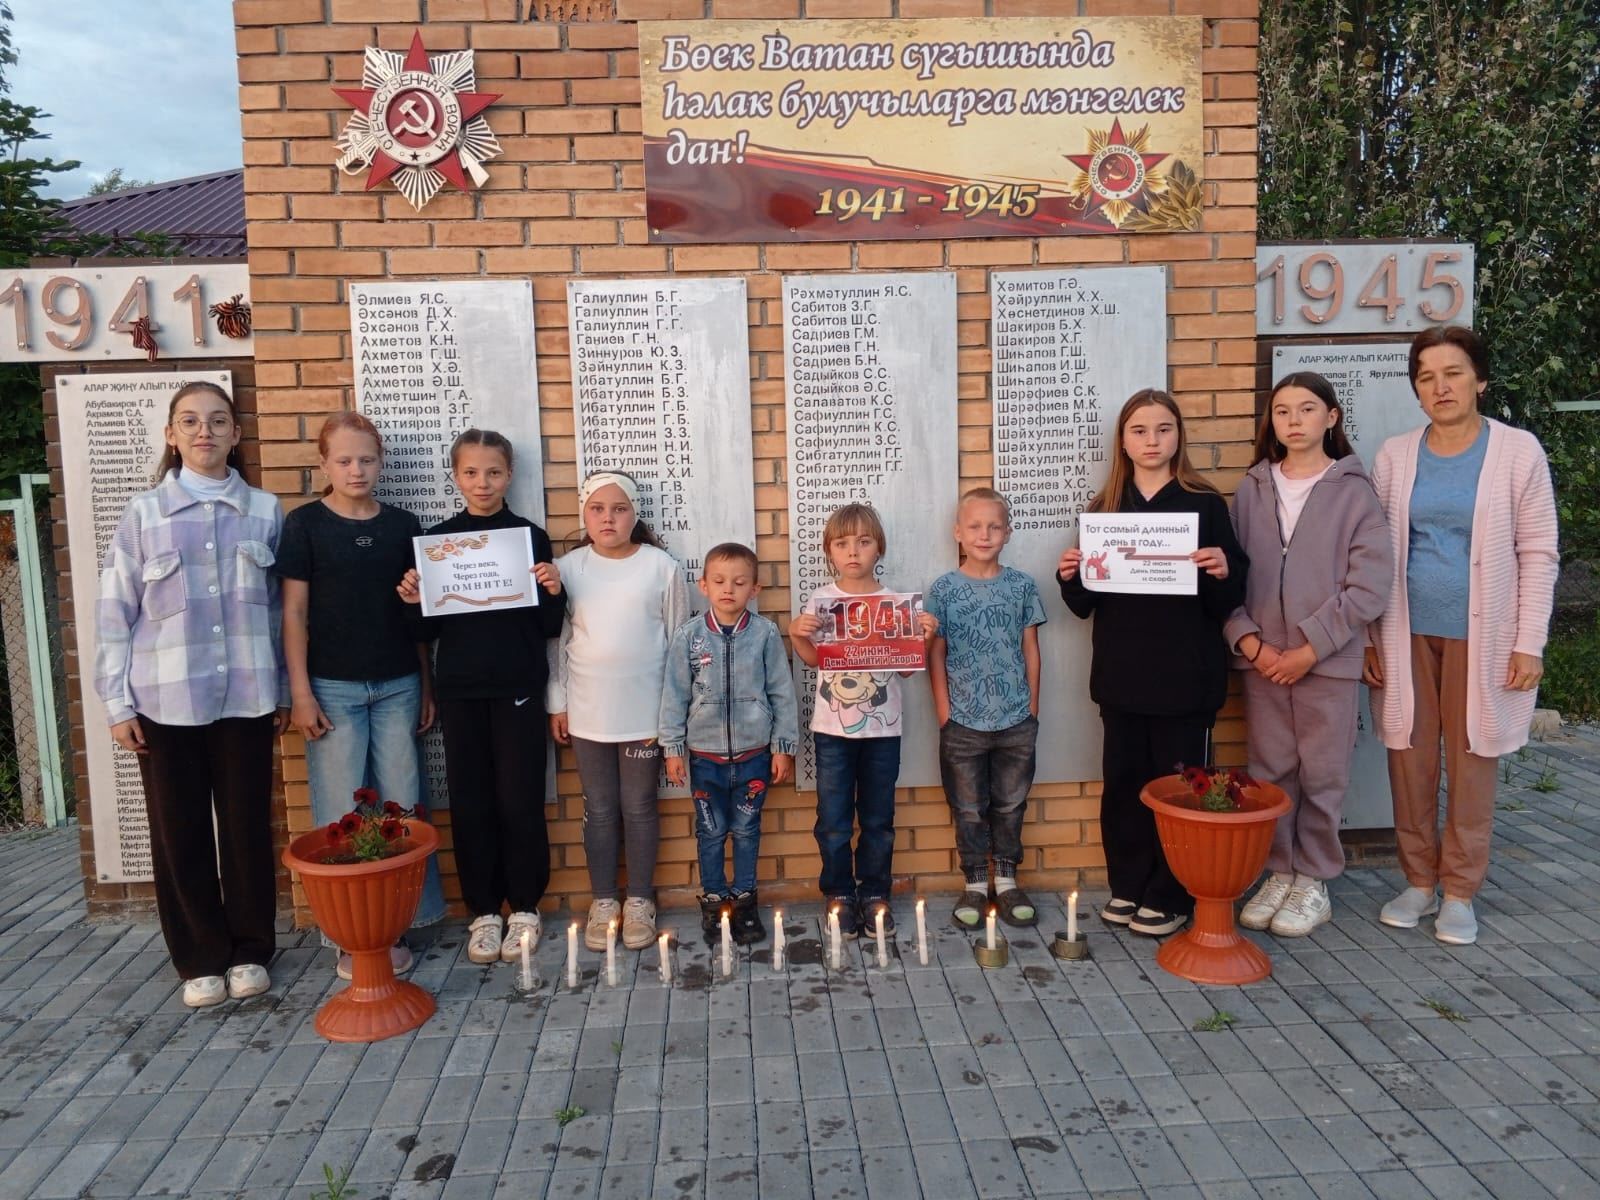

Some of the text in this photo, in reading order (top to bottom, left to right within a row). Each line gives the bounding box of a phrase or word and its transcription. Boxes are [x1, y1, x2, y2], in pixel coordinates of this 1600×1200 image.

[661, 31, 1114, 80] Бөек Ватан сүгышында
[662, 79, 1186, 128] һәлак булучыларга мәнгелек
[665, 130, 750, 169] дан!
[814, 185, 906, 221] 1941
[945, 183, 1041, 219] 1945
[997, 281, 1054, 292] Хәмитов
[1258, 252, 1465, 324] 1945
[358, 294, 411, 306] Әлмиев
[575, 292, 647, 306] Галиуллин
[791, 288, 880, 301] Рәхмәтуллин
[997, 292, 1072, 306] Хәйруллин
[0, 274, 204, 351] 1941
[358, 308, 418, 319] Әхсәнов
[576, 306, 648, 320] Галиуллин
[792, 302, 847, 313] Сабитов
[998, 307, 1085, 320] Хөснетдинов
[360, 321, 419, 332] Әхсәнов
[576, 320, 649, 333] Галиуллин
[792, 315, 847, 327] Сабитов
[997, 321, 1055, 334] Шакиров
[361, 336, 421, 347] Ахметов
[577, 334, 625, 345] Ганиев
[792, 329, 850, 342] Садриев
[997, 335, 1055, 348] Шакиров
[793, 342, 850, 355] Садриев
[997, 349, 1056, 361] Шиһапов
[361, 350, 422, 361] Ахметов
[362, 364, 423, 374] Ахметов
[579, 360, 653, 373] Зәйнуллин
[793, 357, 850, 368] Садриев
[997, 363, 1056, 374] Шиһапов
[363, 377, 424, 388] Ахметов
[580, 375, 654, 387] Ибатуллин
[794, 370, 859, 382] Садыйков
[998, 376, 1056, 387] Шиһапов
[580, 388, 654, 401] Ибатуллин
[794, 383, 859, 395] Садыйков
[998, 388, 1069, 402] Шәрәфиев
[364, 391, 436, 402] Ахметшин
[795, 397, 866, 408] Салаватов
[364, 404, 440, 417] Бахтияров
[581, 402, 655, 415] Ибатуллин
[998, 402, 1069, 415] Шәрәфиев
[582, 416, 656, 428] Ибатуллин
[795, 410, 870, 423] Сафиуллин
[998, 415, 1069, 428] Шәрәфиев
[582, 429, 656, 442] Ибатуллин
[795, 423, 870, 436] Сафиуллин
[583, 443, 657, 455] Ибатуллин
[796, 436, 871, 449] Сафиуллин
[1086, 524, 1189, 534] Тот самый длинный
[1103, 539, 1128, 547] день
[828, 600, 914, 640] 1941
[844, 646, 859, 657] 22
